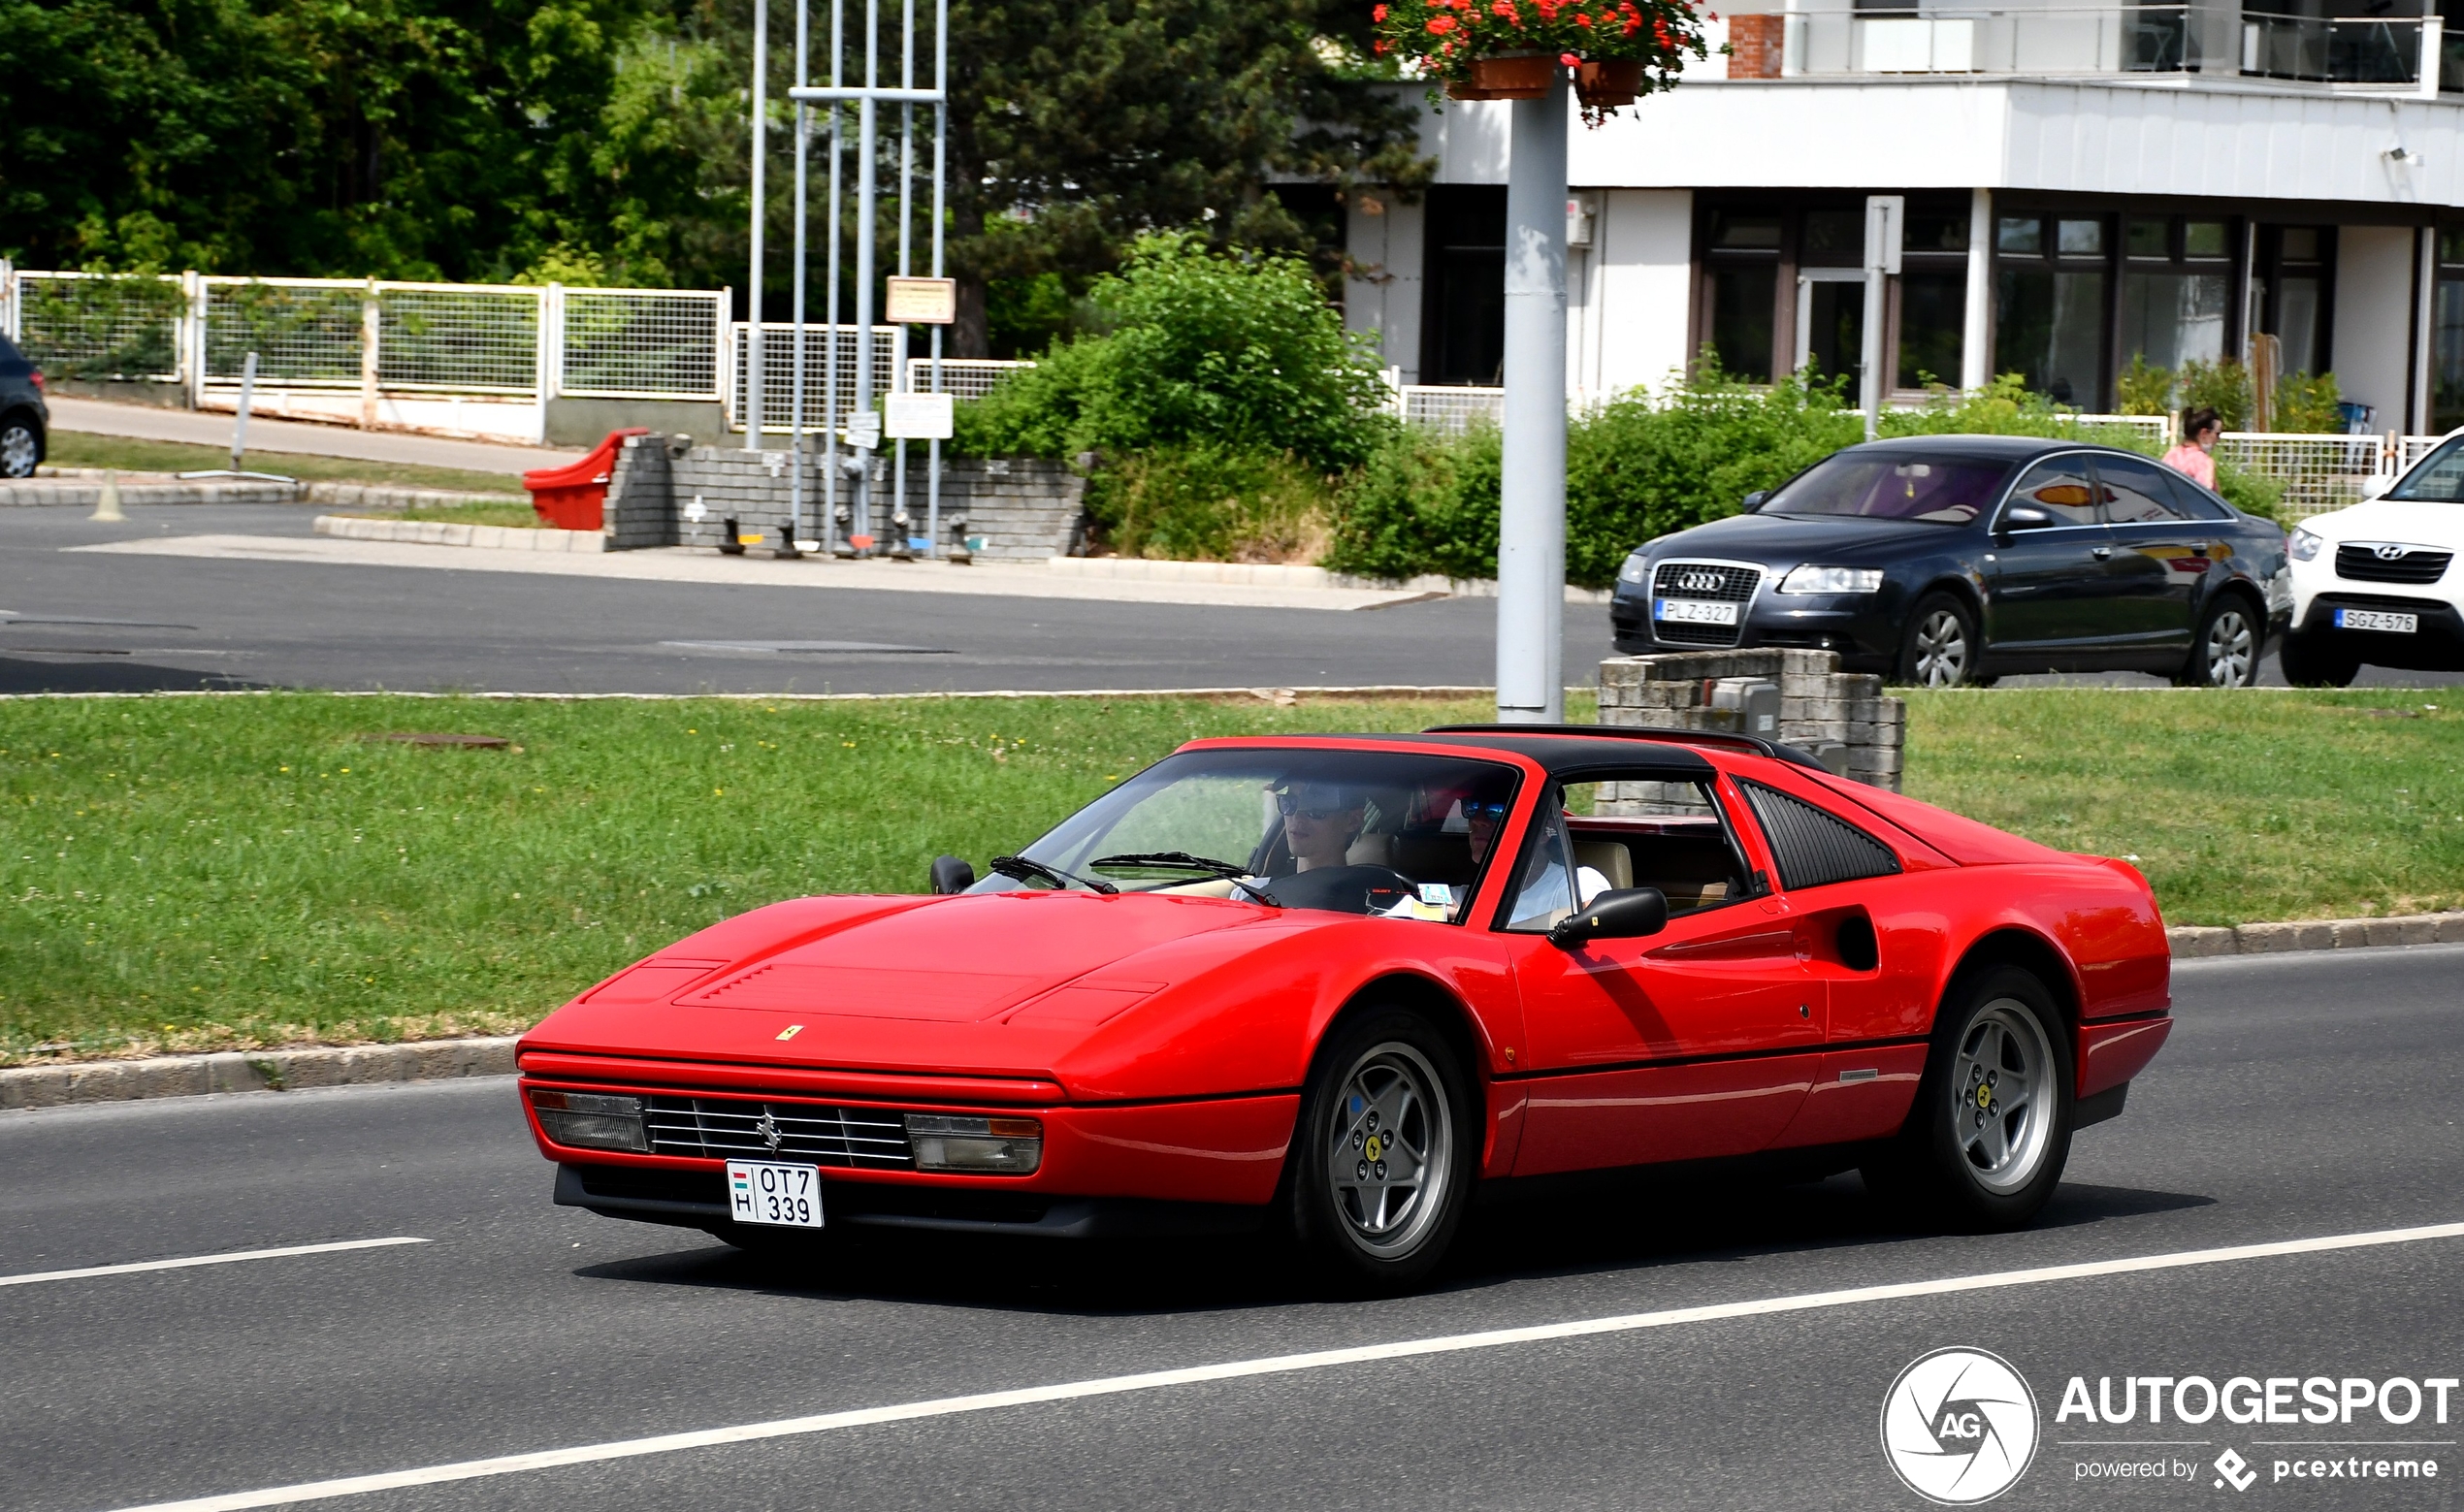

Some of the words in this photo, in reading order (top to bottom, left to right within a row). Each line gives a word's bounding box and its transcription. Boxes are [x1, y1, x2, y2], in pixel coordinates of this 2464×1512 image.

[1666, 603, 1733, 621] PLZ-327
[2347, 612, 2413, 630] SGZ-576
[735, 1193, 751, 1212] H
[768, 1196, 810, 1222] 339
